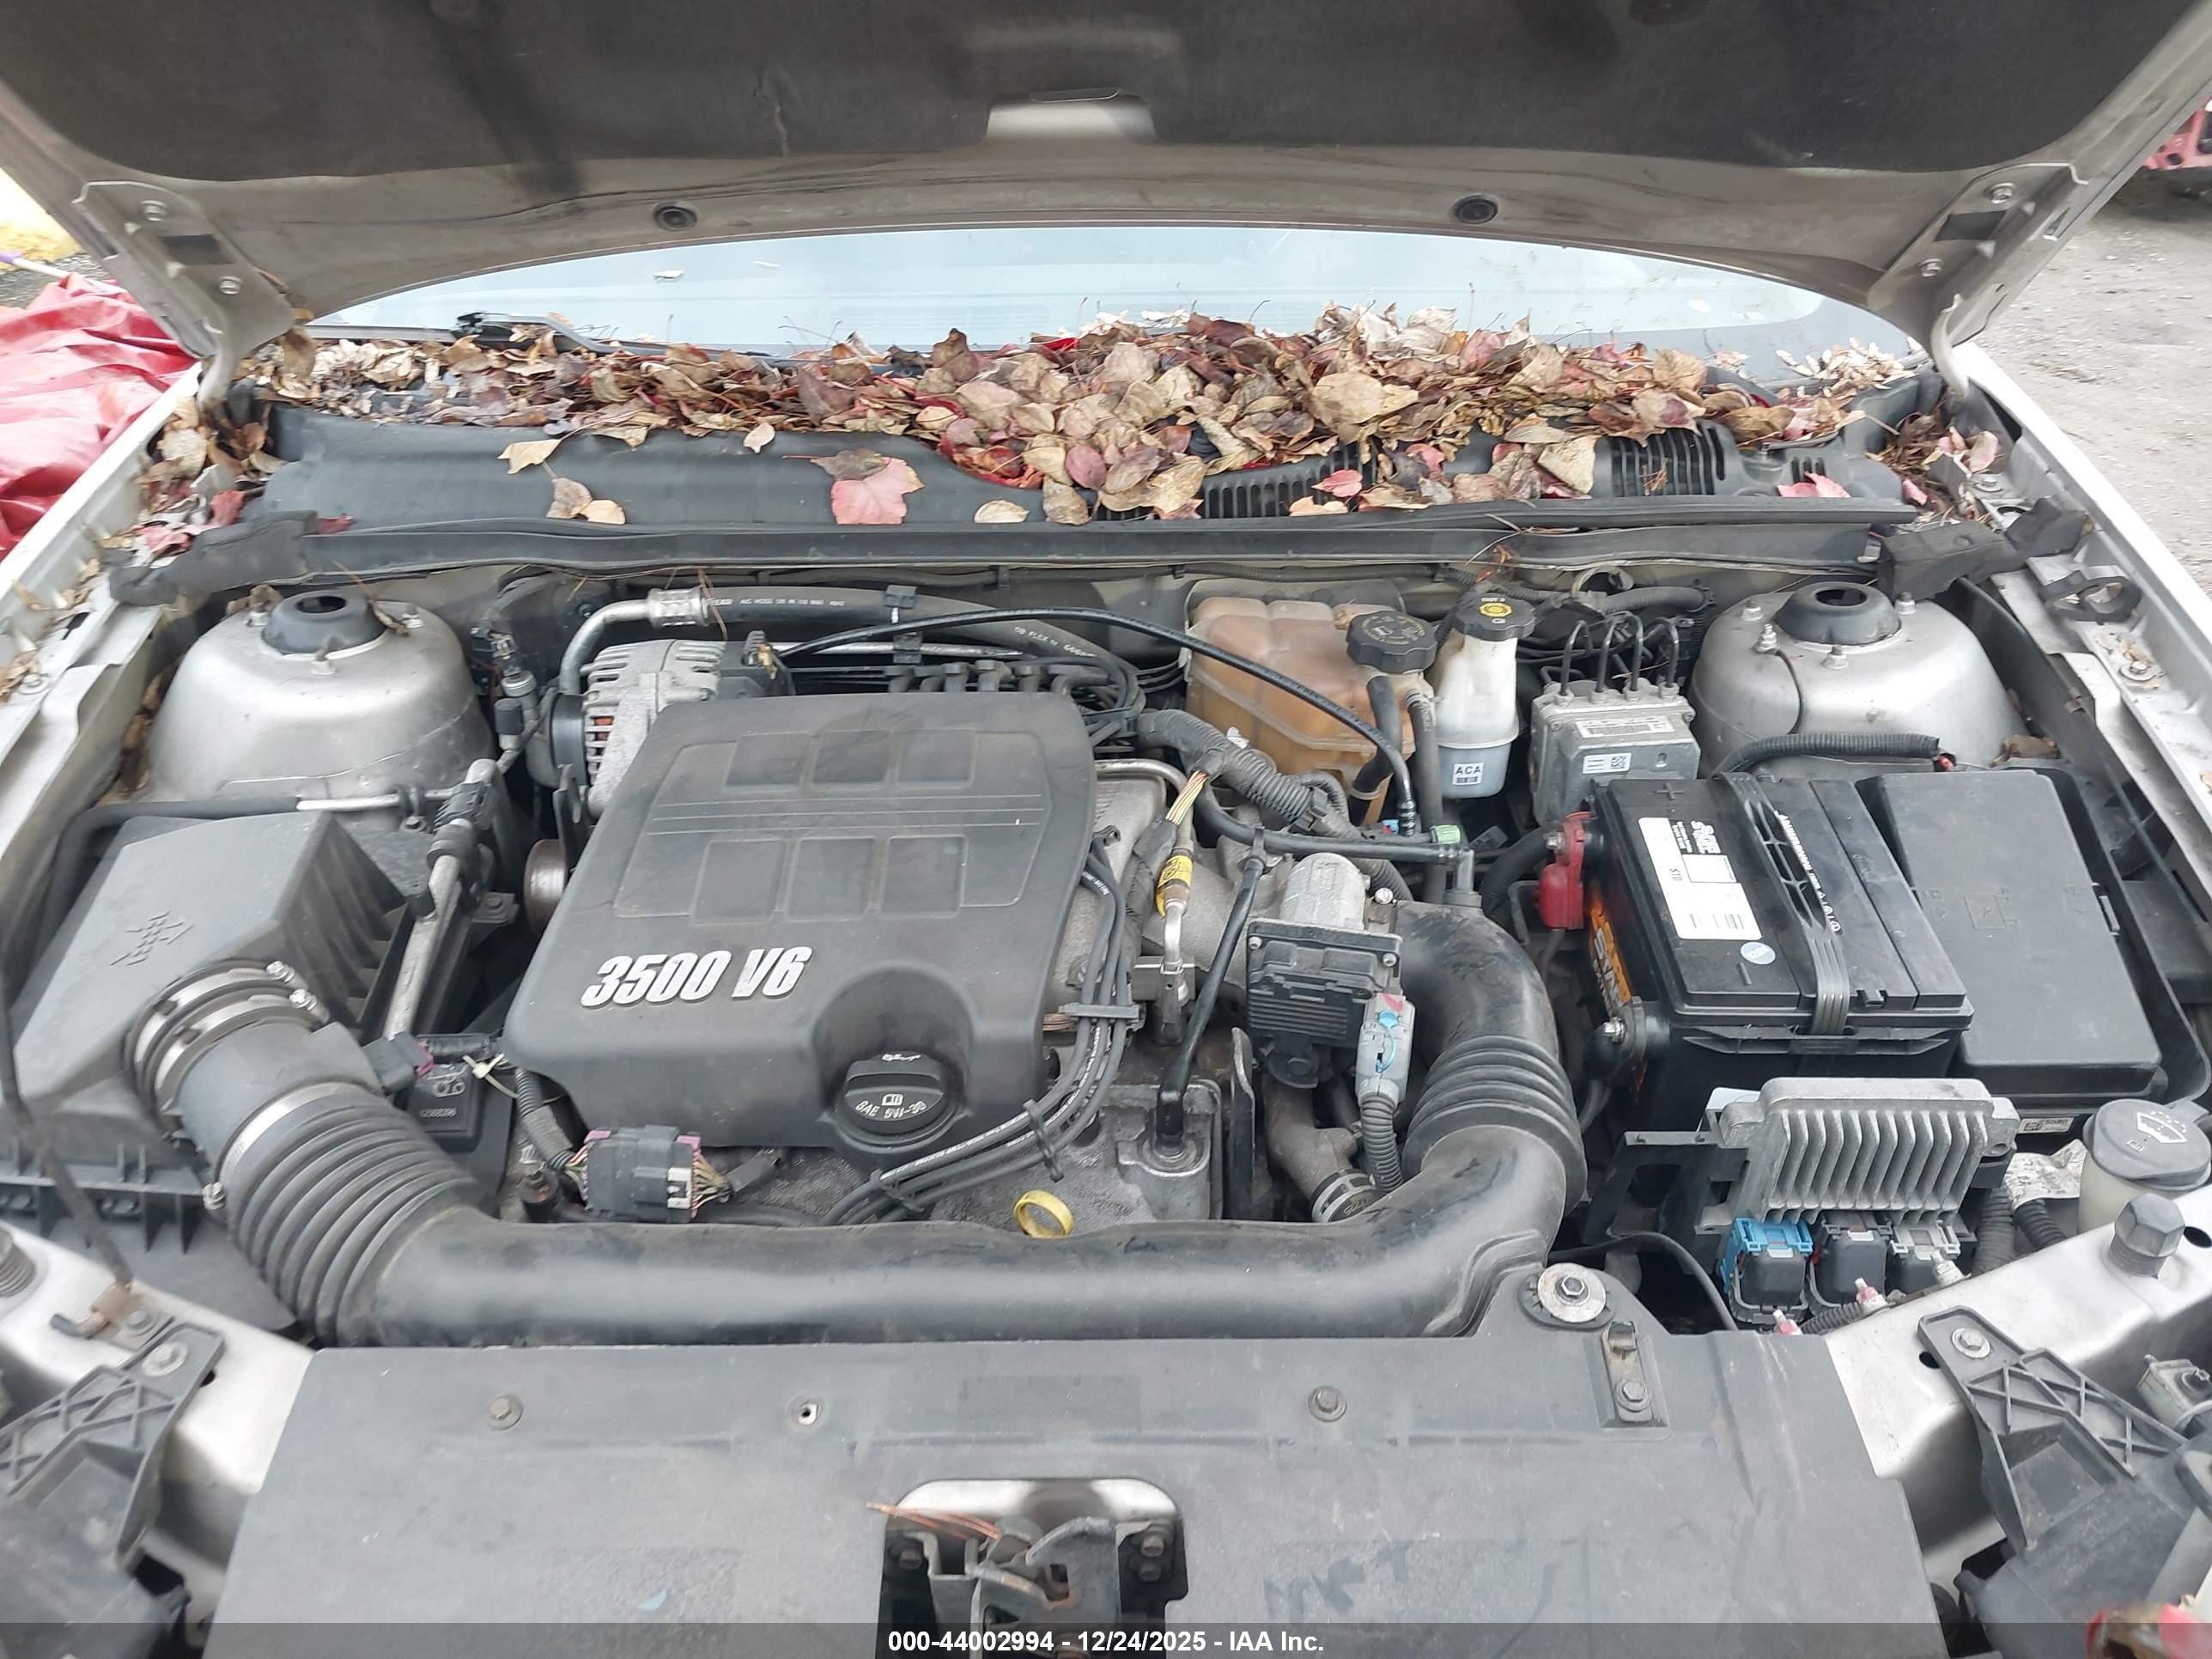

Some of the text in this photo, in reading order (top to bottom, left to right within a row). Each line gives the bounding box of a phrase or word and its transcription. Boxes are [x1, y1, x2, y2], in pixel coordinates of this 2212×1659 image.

[1455, 766, 1480, 775] ACA
[580, 946, 812, 1007] 3500 V6
[855, 1100, 927, 1119] SAE 5W-30
